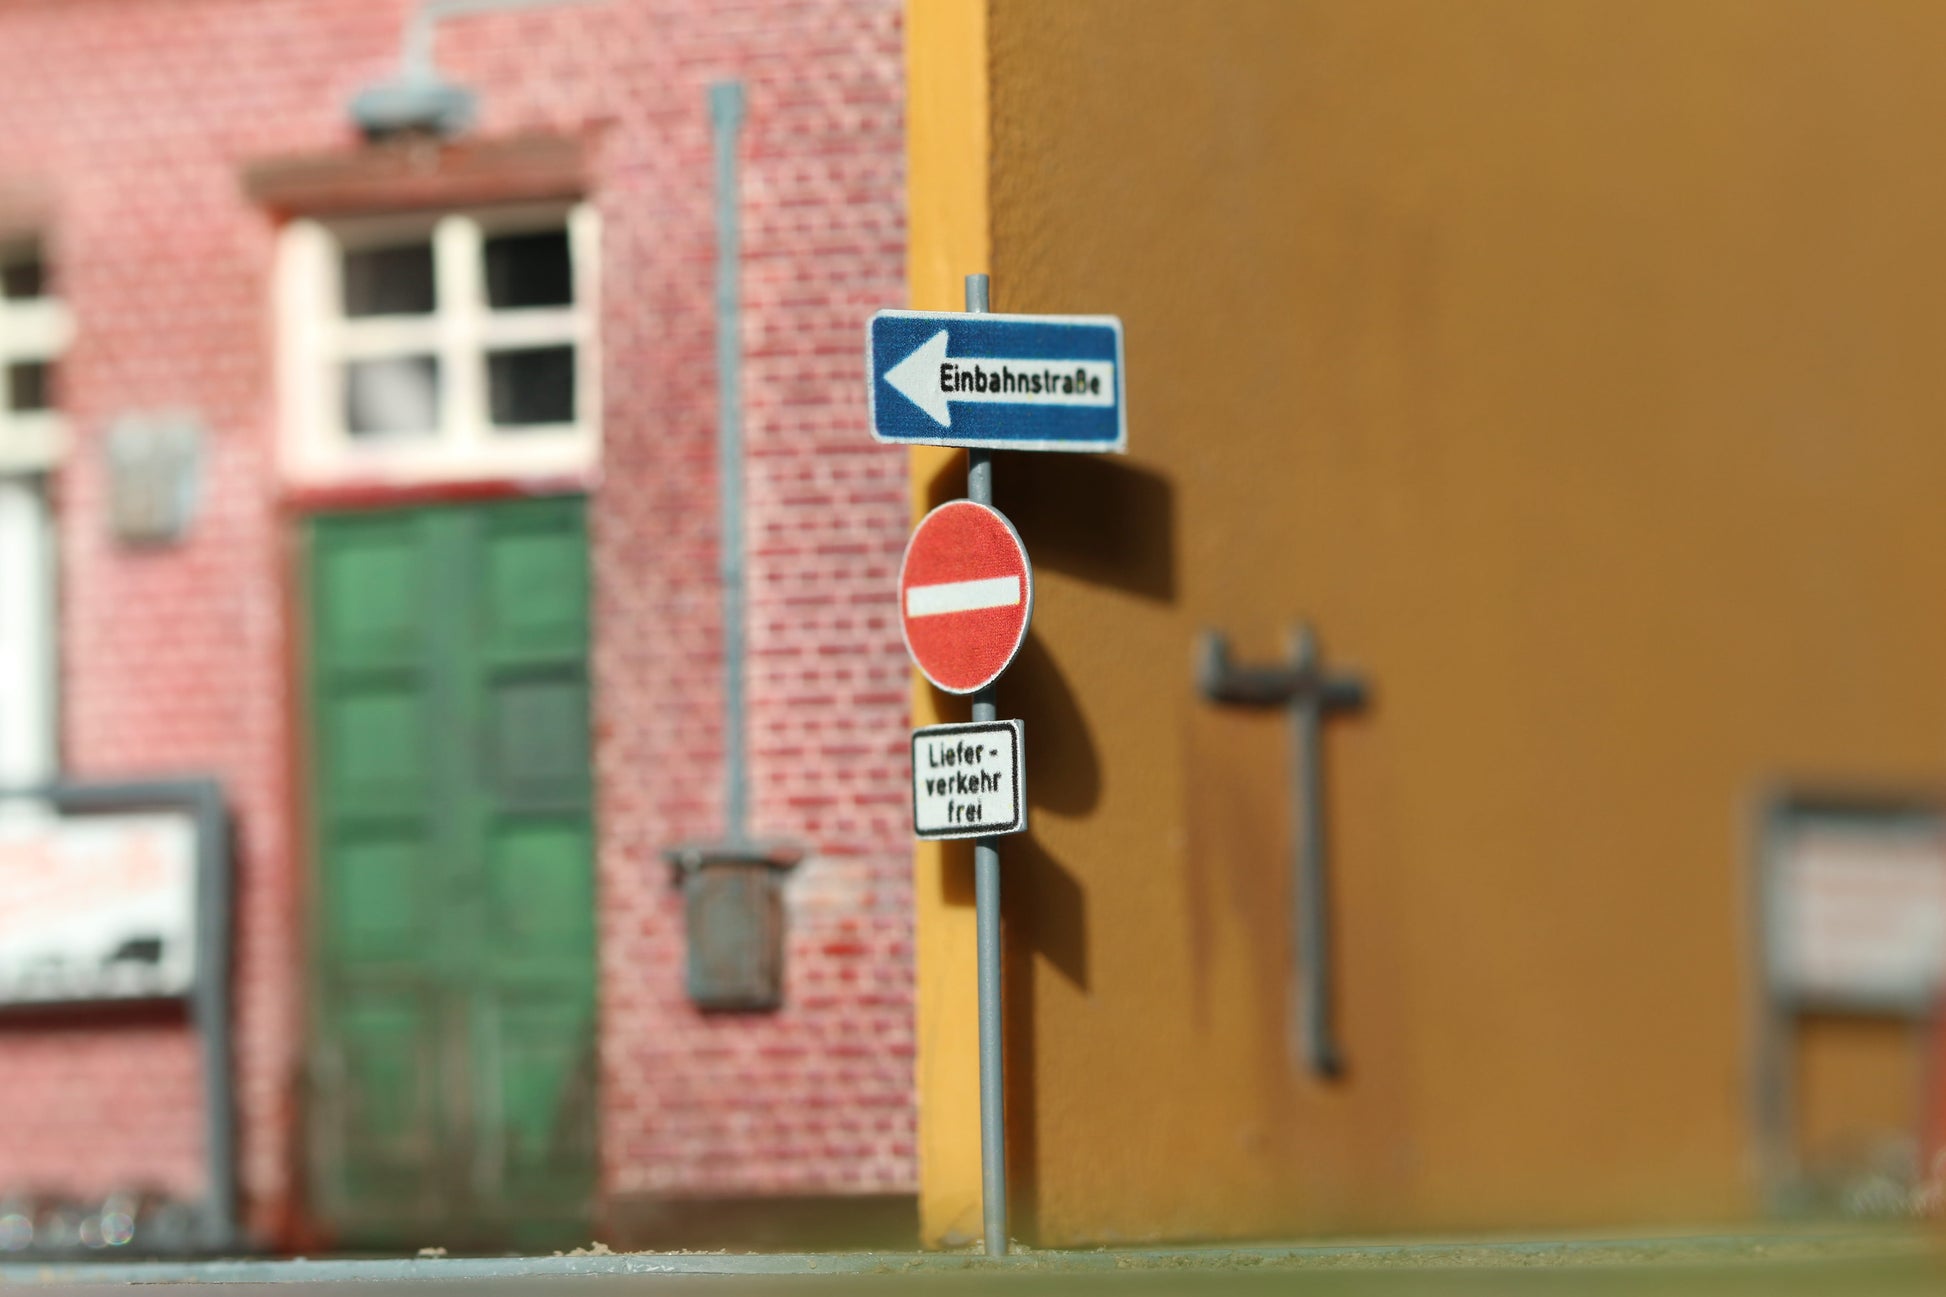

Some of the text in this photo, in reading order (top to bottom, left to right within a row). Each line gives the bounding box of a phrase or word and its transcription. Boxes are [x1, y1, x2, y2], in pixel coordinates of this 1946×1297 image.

[940, 363, 1100, 395] Einbahnstraße
[926, 769, 1002, 797] verkehr
[948, 798, 982, 823] frei
